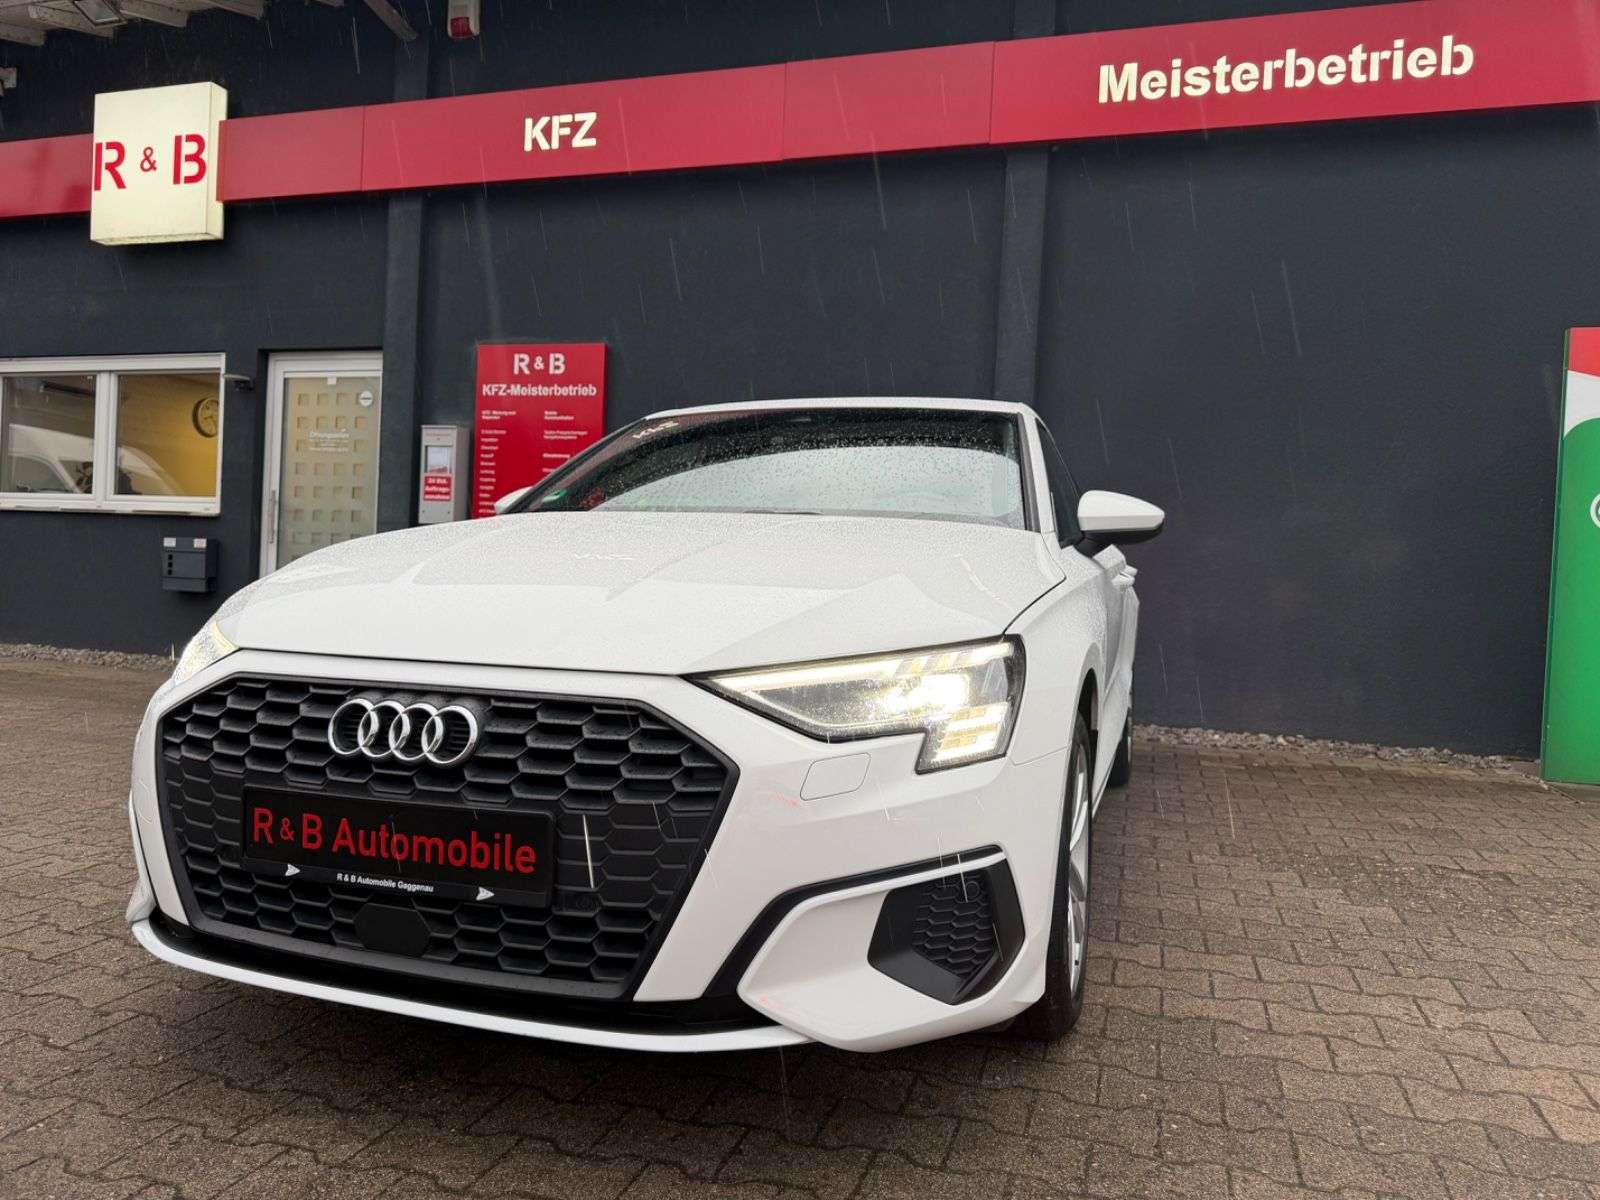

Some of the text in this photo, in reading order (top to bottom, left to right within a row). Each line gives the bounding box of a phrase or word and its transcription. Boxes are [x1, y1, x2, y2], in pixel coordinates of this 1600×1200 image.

[1099, 35, 1475, 104] Meisterbetrieb
[523, 111, 598, 152] KFZ
[93, 133, 208, 192] R & B
[513, 352, 566, 376] R & B
[481, 383, 597, 397] KFZ-Meisterbetrieb
[253, 807, 537, 874] R & B Automobile
[336, 872, 343, 881] R
[343, 873, 350, 882] &
[356, 875, 397, 888] Automobile
